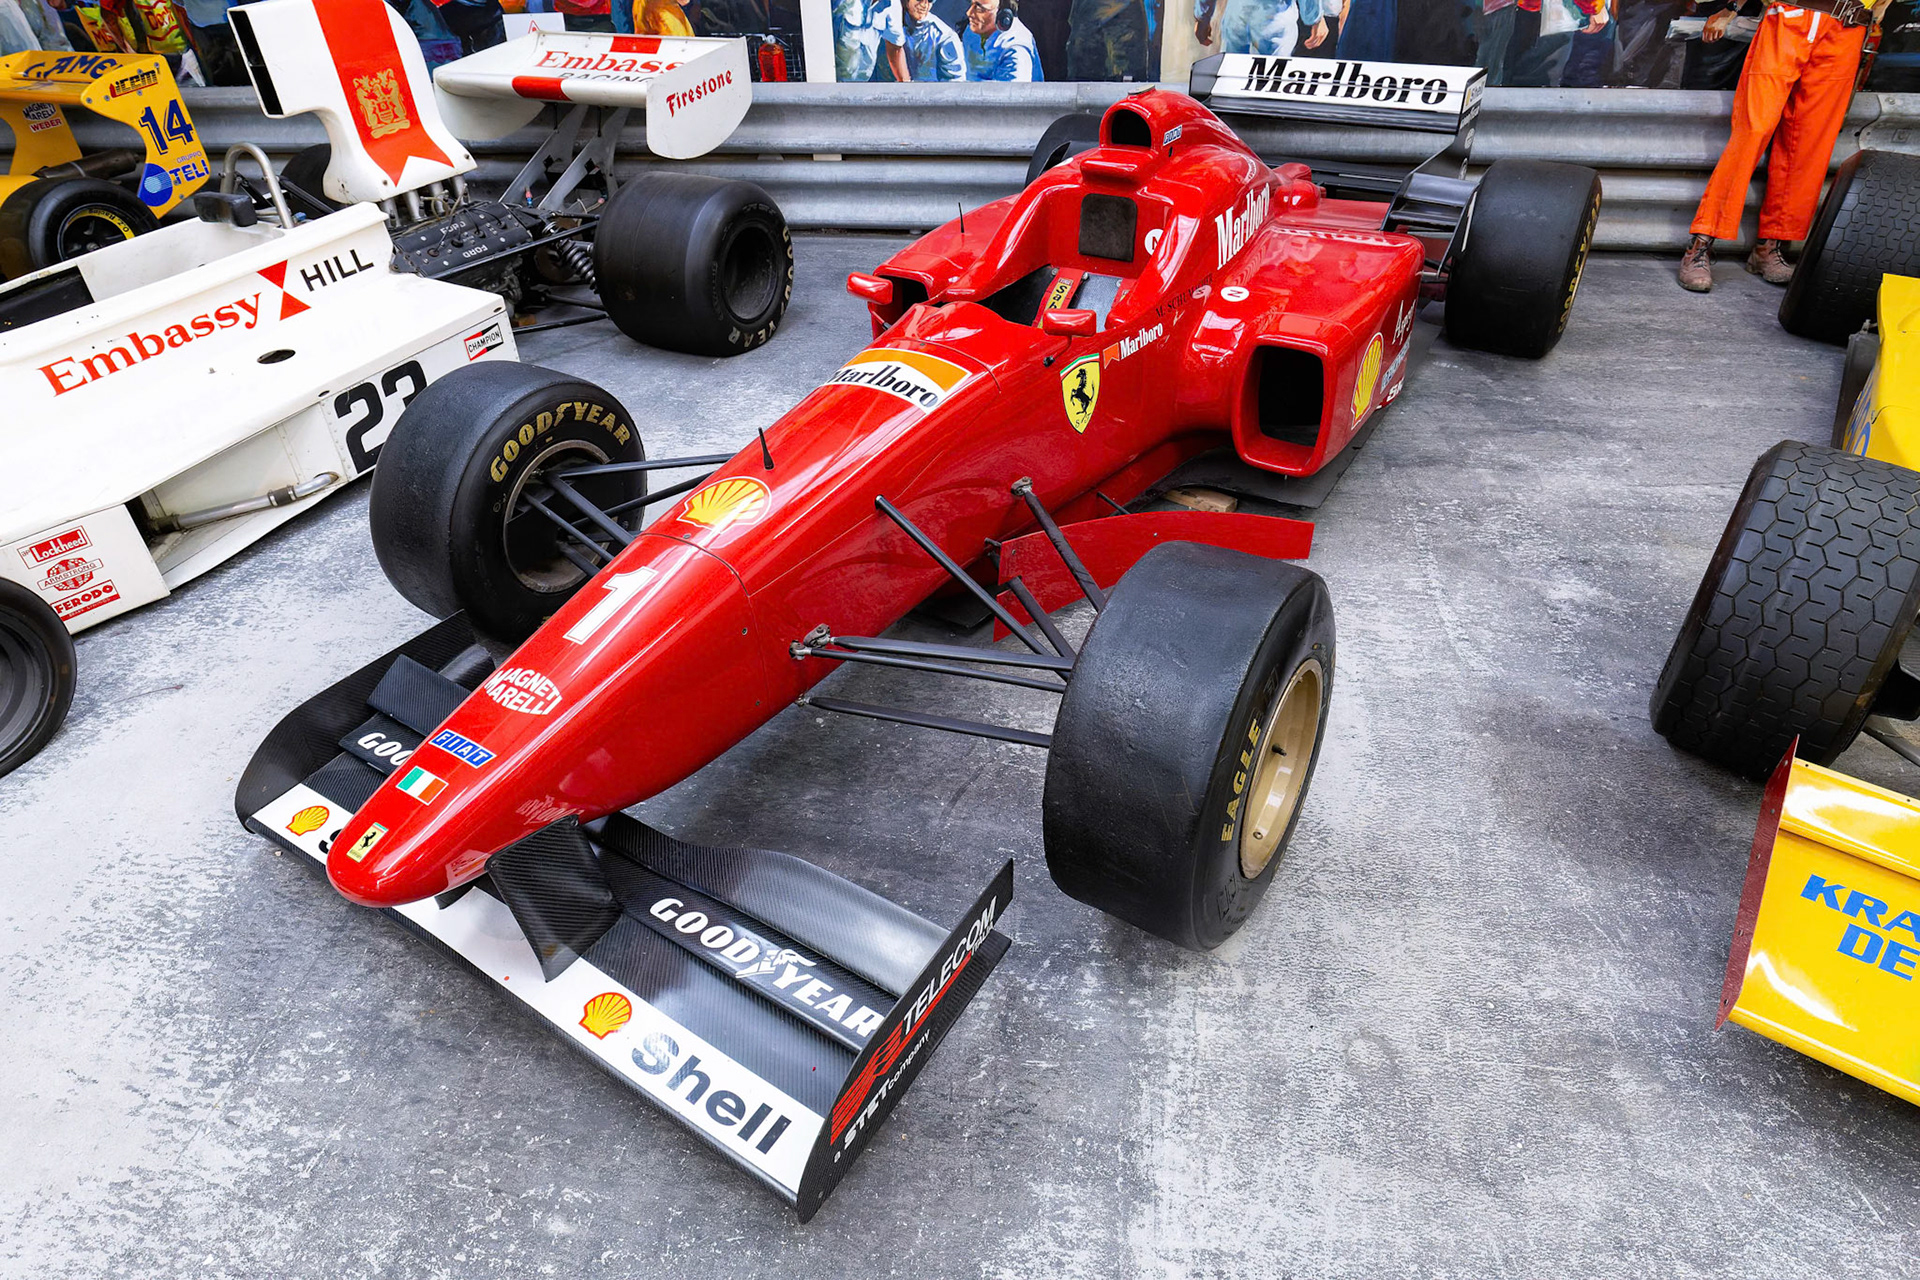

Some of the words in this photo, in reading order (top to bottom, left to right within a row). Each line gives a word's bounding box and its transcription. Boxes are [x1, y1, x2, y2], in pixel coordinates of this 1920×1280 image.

[666, 69, 733, 118] Firestone
[1241, 57, 1448, 105] Marlboro
[31, 118, 62, 131] WEBER
[139, 99, 194, 155] 14
[176, 151, 202, 163] GRUPPO
[462, 244, 488, 258] FORD
[38, 293, 261, 397] Embassy
[300, 250, 374, 291] HILL
[468, 331, 500, 353] CHAMPION
[1120, 323, 1163, 360] Marlboro
[32, 530, 85, 560] Lockheed
[44, 562, 97, 587] ARMSTRONG
[54, 585, 114, 613] FERODO
[563, 566, 659, 645] 1
[435, 732, 488, 762] FIAT
[1221, 719, 1262, 842] EAGLE
[904, 896, 997, 1035] TELECOM
[631, 1032, 792, 1155] Shell
[844, 1078, 890, 1150] STET
[888, 1029, 930, 1090] company
